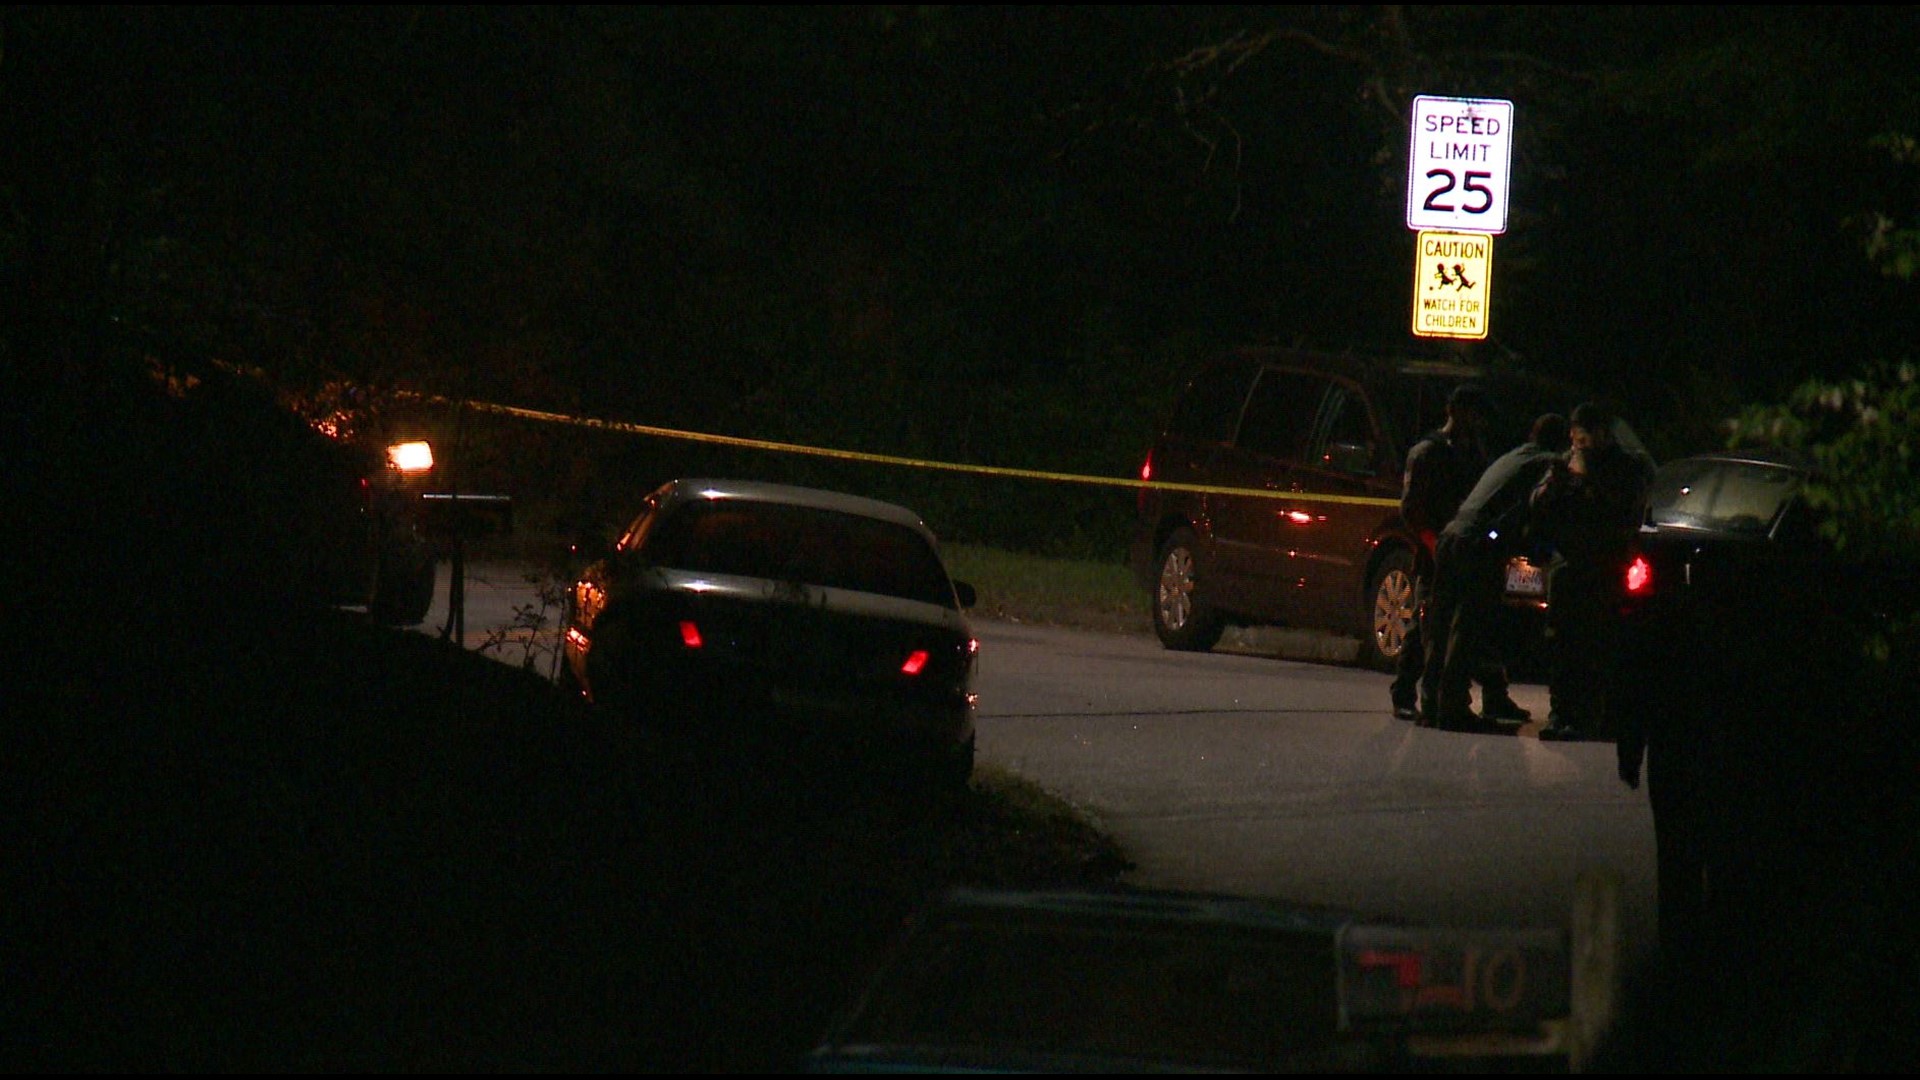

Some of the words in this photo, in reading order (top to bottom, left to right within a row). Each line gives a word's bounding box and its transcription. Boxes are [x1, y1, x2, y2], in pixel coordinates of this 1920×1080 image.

[1425, 114, 1500, 136] SPEED
[1430, 141, 1491, 162] LIMIT
[1423, 168, 1493, 214] 25
[1425, 239, 1484, 259] CAUTION
[1424, 298, 1455, 312] WATCH
[1460, 299, 1480, 313] FOR
[1425, 314, 1476, 329] CHILDREN
